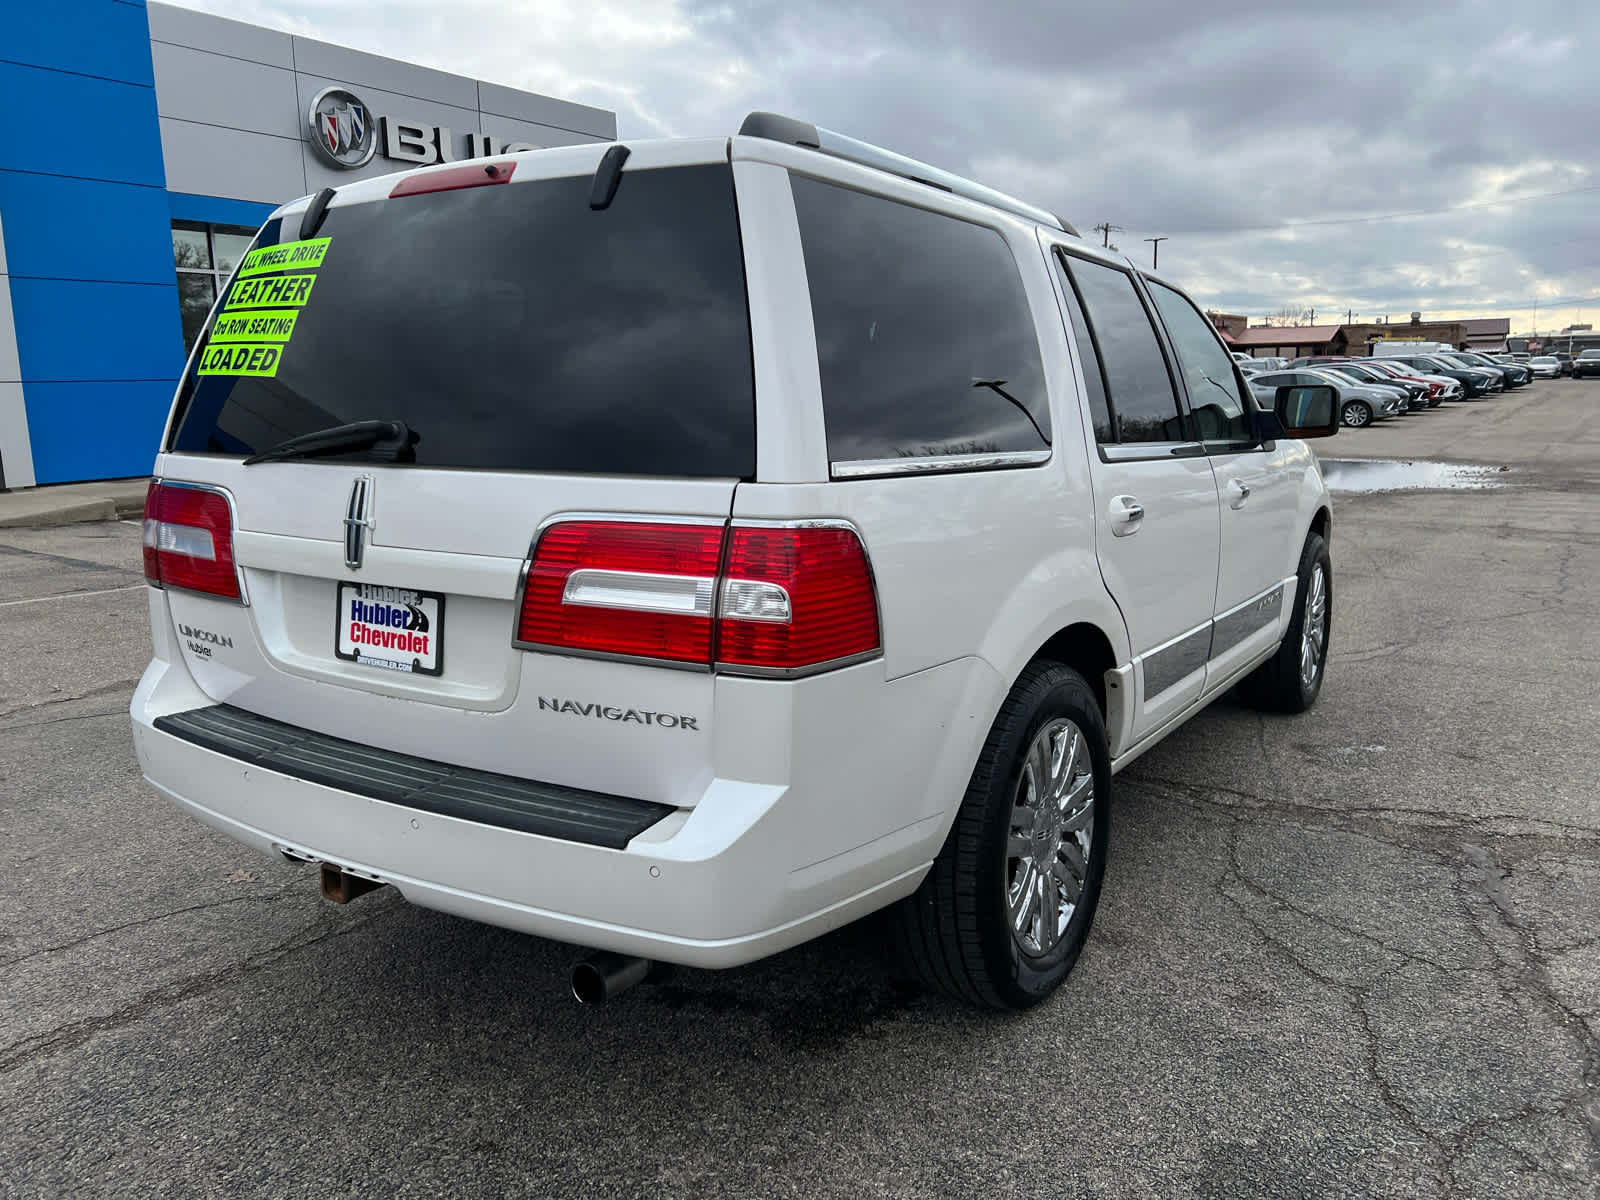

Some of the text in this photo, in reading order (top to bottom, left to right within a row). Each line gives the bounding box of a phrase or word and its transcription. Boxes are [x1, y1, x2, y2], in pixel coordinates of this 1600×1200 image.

[383, 116, 545, 164] BUI
[241, 243, 326, 271] ALL WHEEL DRIVE
[228, 277, 313, 305] LEATHER
[213, 317, 293, 336] 3rd ROW SEATING
[200, 348, 279, 372] LOADED
[351, 599, 411, 629] Hubler
[178, 623, 234, 648] LINCOLN
[350, 621, 429, 656] Chevrolet
[537, 695, 700, 731] NAVIGATOR
